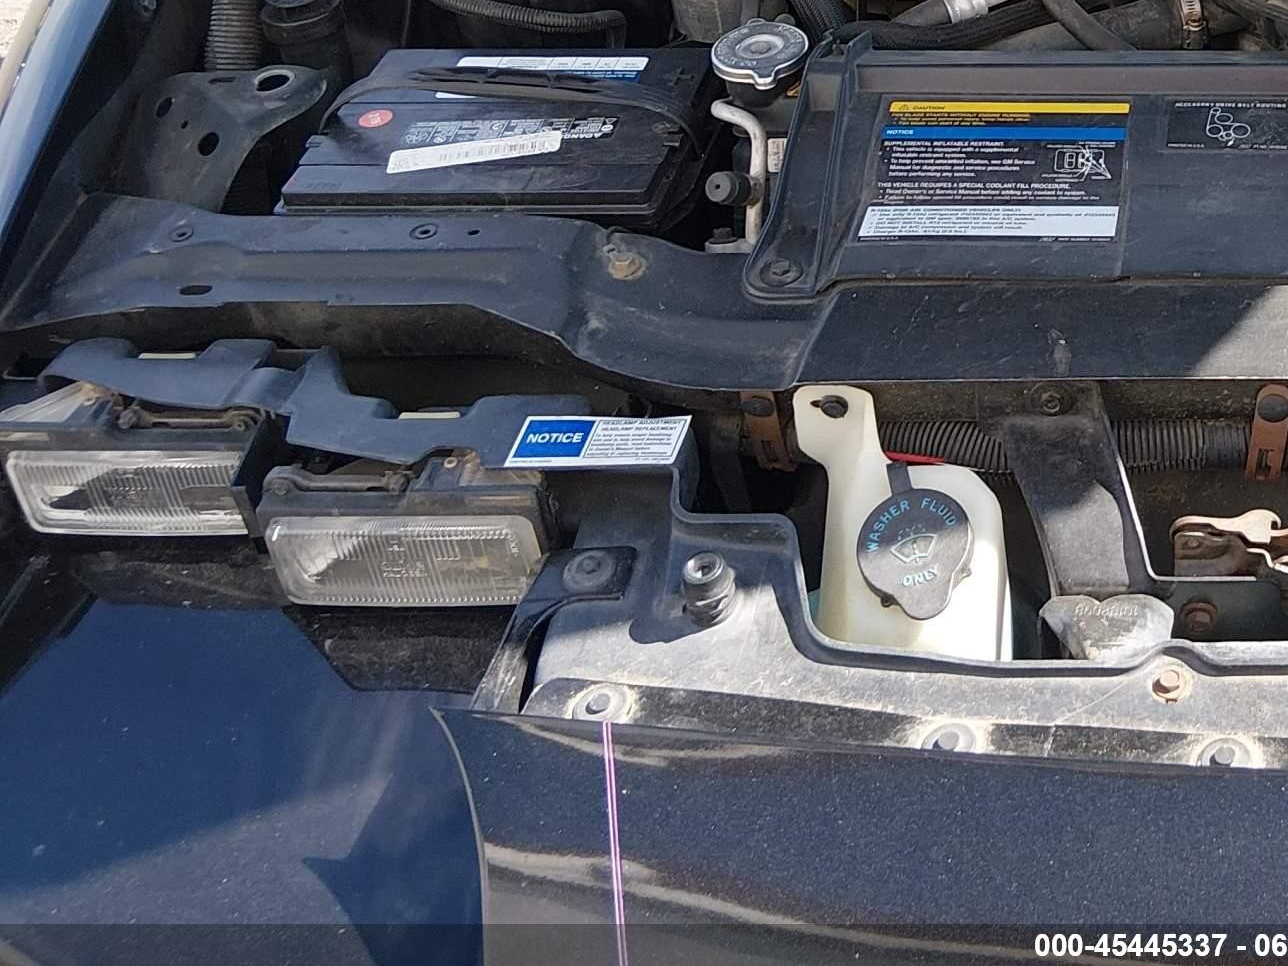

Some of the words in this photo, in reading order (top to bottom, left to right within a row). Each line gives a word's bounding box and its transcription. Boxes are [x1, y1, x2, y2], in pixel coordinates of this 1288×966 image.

[526, 432, 584, 444] NOTICE
[866, 499, 911, 554] WASHER
[920, 496, 958, 528] FLUID
[901, 567, 940, 587] ONLY
